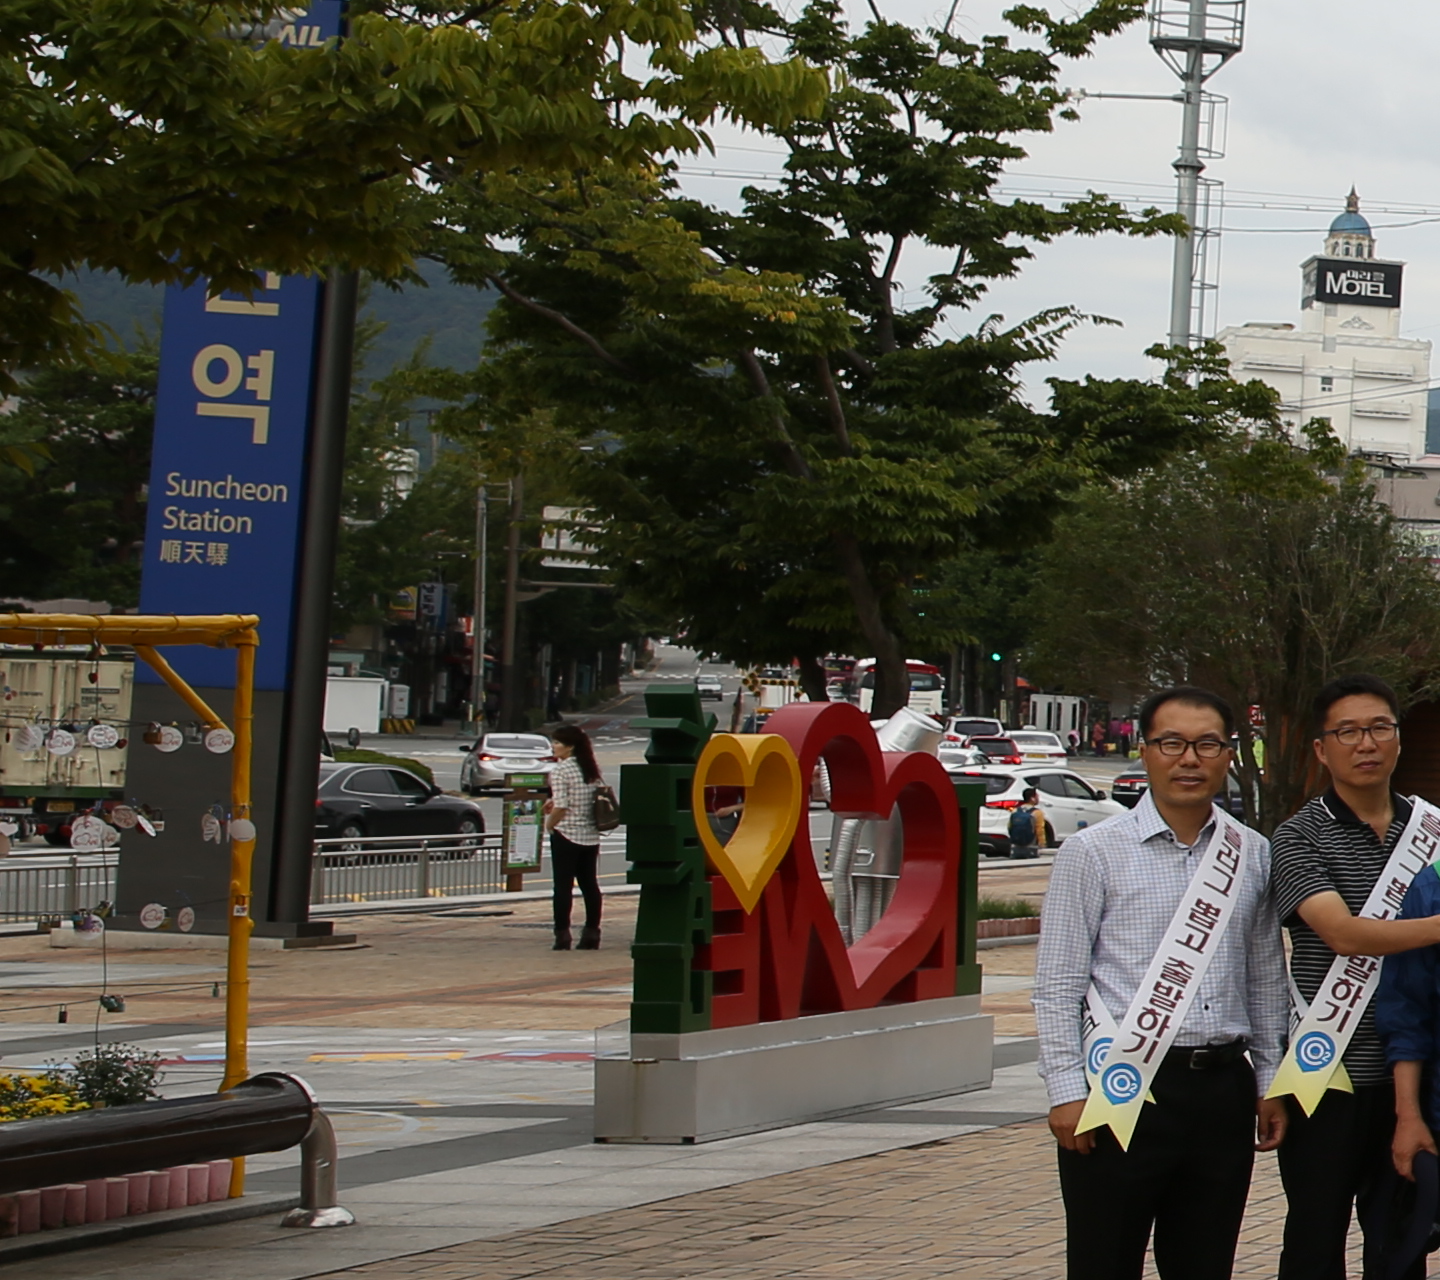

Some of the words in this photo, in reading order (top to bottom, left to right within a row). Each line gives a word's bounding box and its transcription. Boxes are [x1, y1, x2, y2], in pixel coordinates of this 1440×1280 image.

[1325, 271, 1393, 298] MOTEL
[165, 471, 289, 504] Suncheon
[162, 506, 254, 535] Station
[1174, 896, 1222, 956] 뽑고
[1121, 955, 1197, 1066] 출발하기
[1315, 955, 1378, 1034] 발하기
